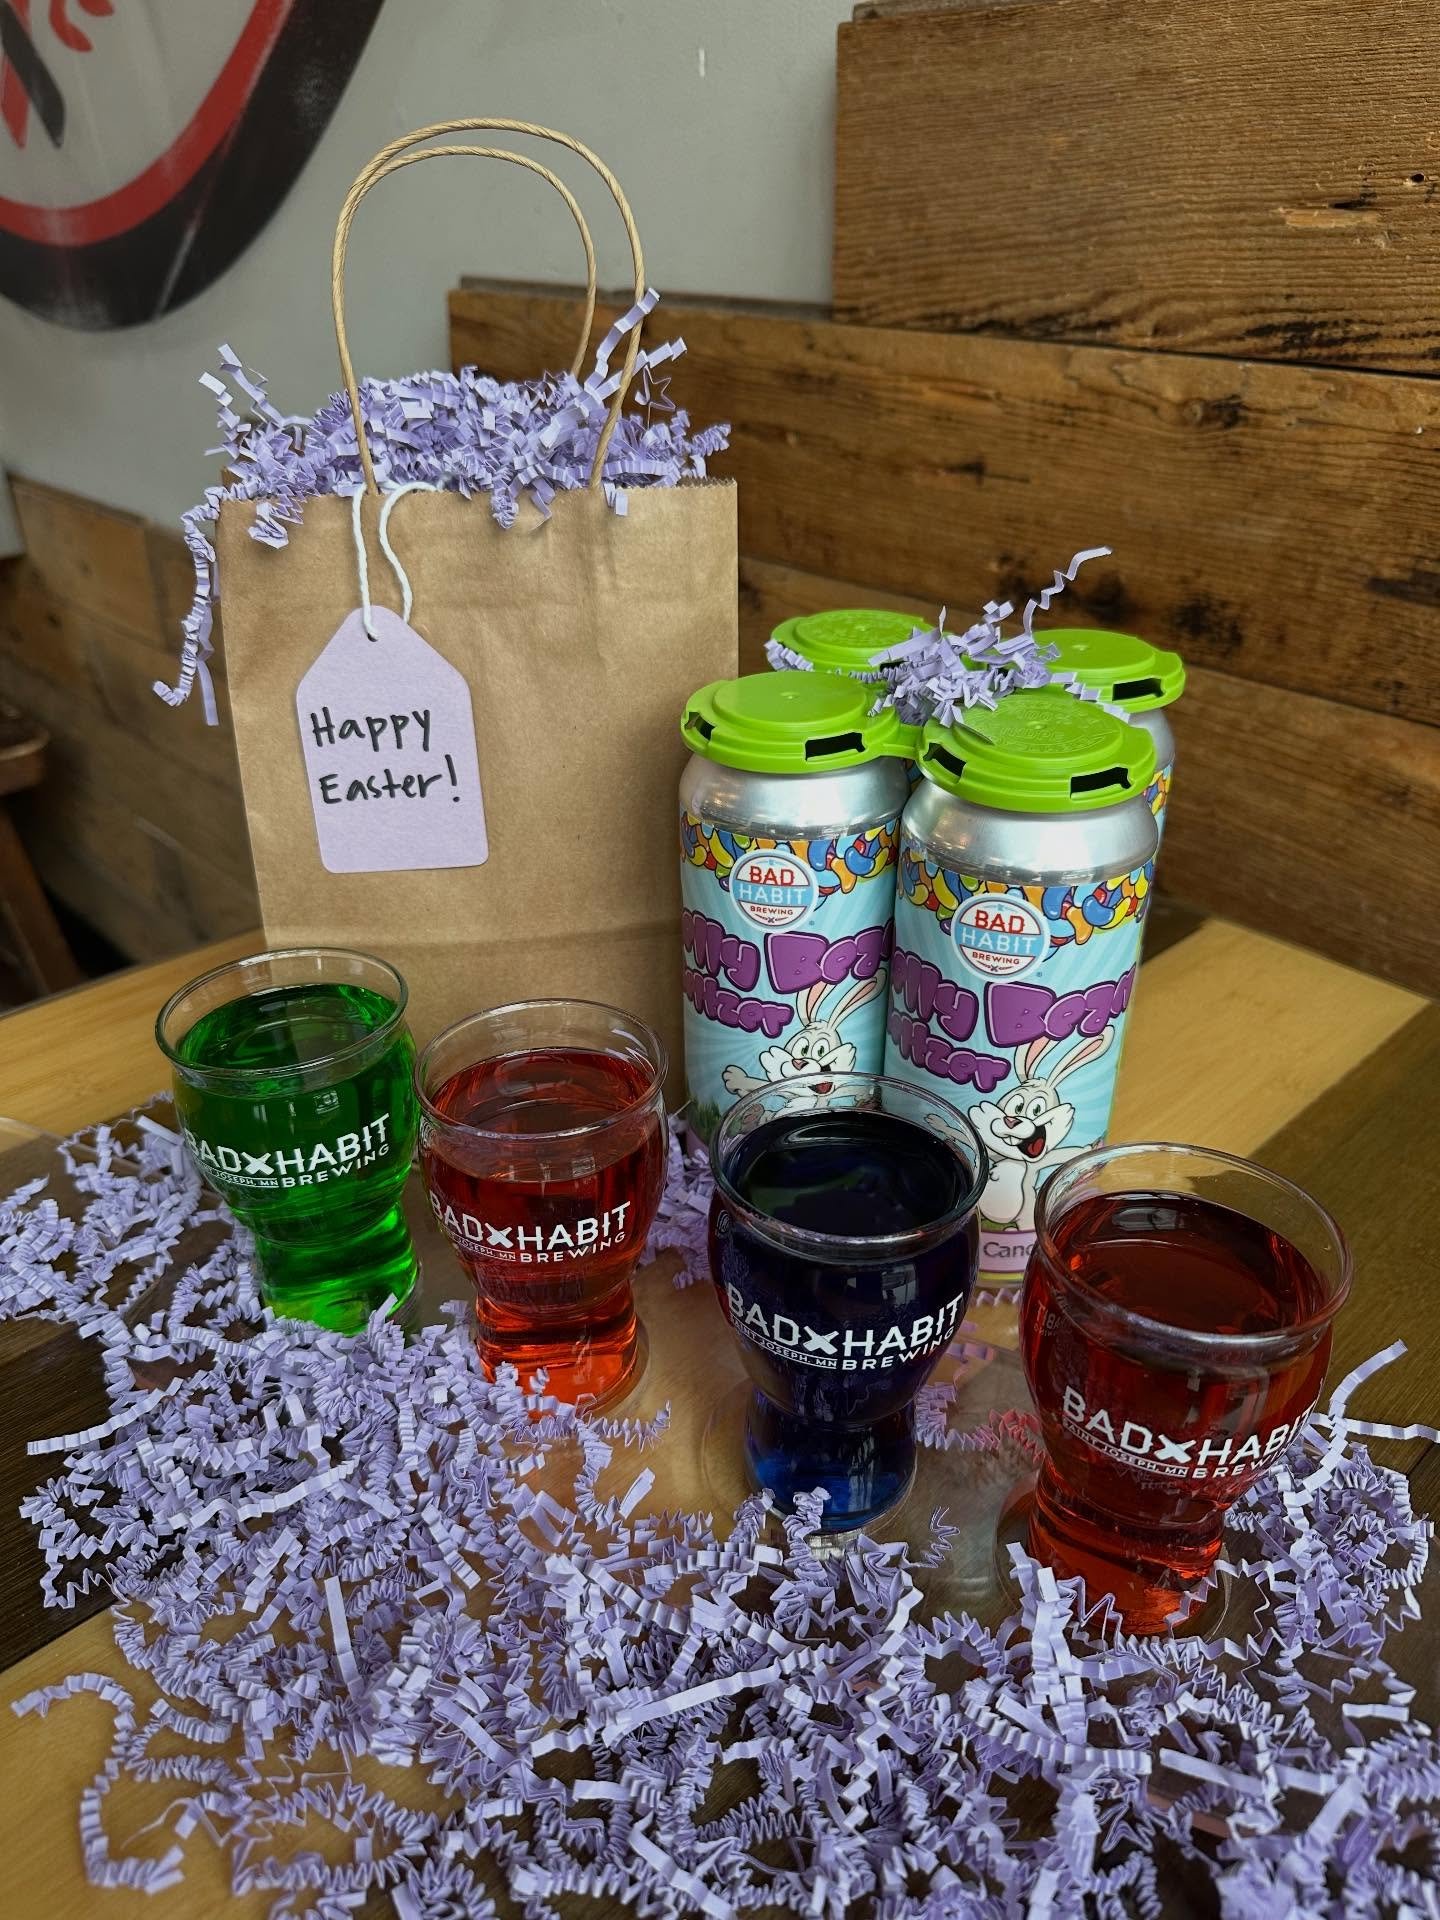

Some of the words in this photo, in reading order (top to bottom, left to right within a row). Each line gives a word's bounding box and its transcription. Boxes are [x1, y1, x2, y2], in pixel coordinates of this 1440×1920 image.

[311, 707, 430, 752] Happy
[319, 754, 460, 804] Easter!
[749, 866, 795, 886] BAD
[738, 882, 806, 905] HABIT
[750, 906, 794, 915] BREWING
[974, 909, 1025, 934] BAD
[962, 927, 1037, 954] HABIT
[972, 951, 1020, 965] BREWING
[184, 1127, 242, 1173] BAD
[276, 1113, 389, 1175] HABIT
[281, 1143, 389, 1188] BREWING
[430, 1190, 484, 1242] BAD
[517, 1201, 631, 1251] HABIT
[520, 1231, 626, 1263] BREWING
[728, 1282, 802, 1347] BAD
[842, 1291, 964, 1357] HABIT
[815, 1358, 838, 1368] MN
[842, 1326, 955, 1370] BREWING
[1062, 1386, 1154, 1455] BAD
[1164, 1465, 1188, 1477] MN
